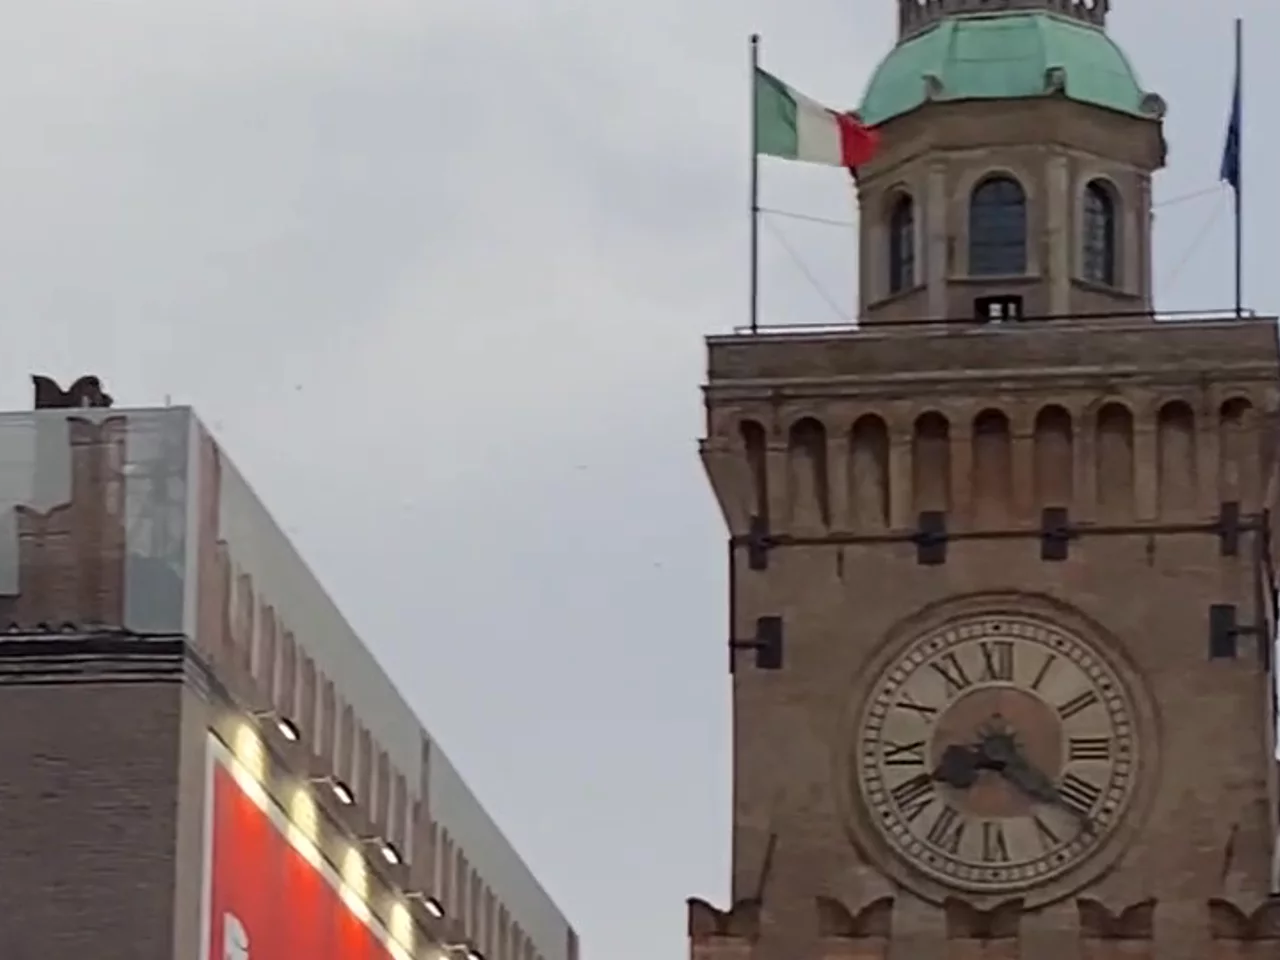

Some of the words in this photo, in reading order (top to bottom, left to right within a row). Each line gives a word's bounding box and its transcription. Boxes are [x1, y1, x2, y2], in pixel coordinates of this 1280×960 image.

[978, 640, 1015, 682] XII
[1029, 653, 1056, 690] I
[895, 690, 938, 725] X
[1057, 689, 1098, 720] II
[883, 740, 926, 766] IX
[1069, 738, 1109, 760] III
[981, 821, 1011, 863] VI
